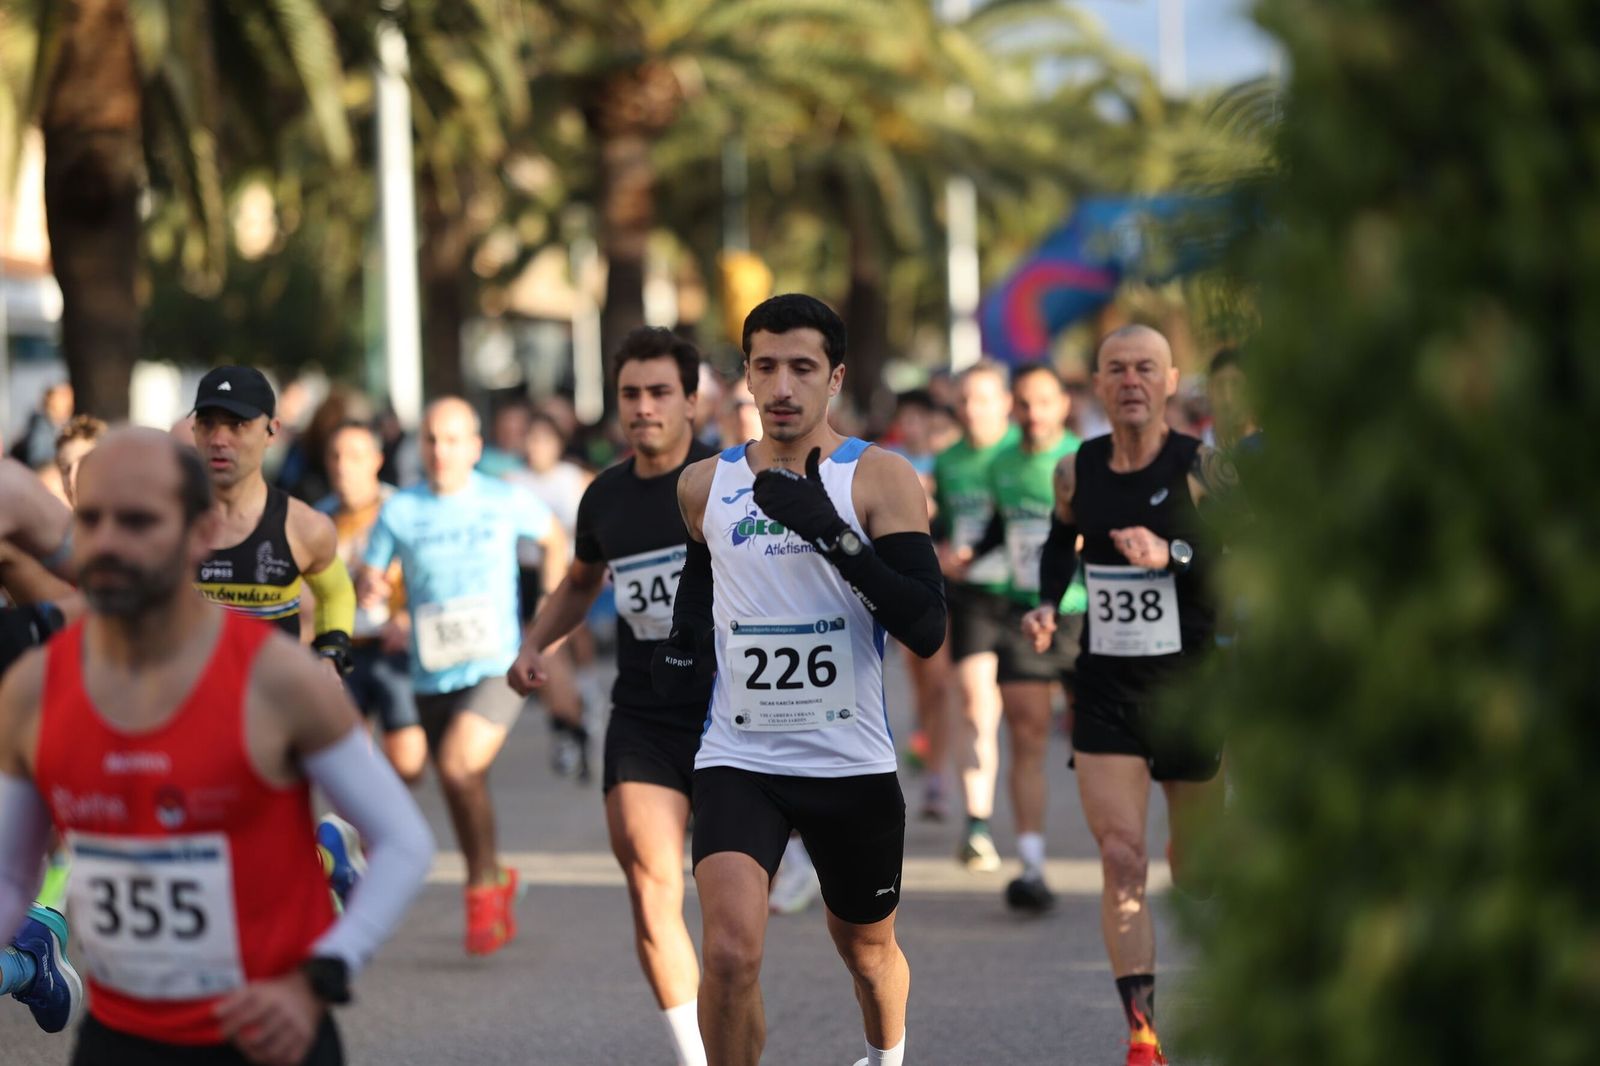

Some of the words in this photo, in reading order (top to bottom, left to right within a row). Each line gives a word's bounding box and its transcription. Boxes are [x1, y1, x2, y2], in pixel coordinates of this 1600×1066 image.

[627, 570, 682, 614] 34
[1097, 589, 1164, 624] 338
[665, 655, 694, 667] KIPRUN
[743, 644, 838, 691] 226
[89, 876, 208, 943] 355
